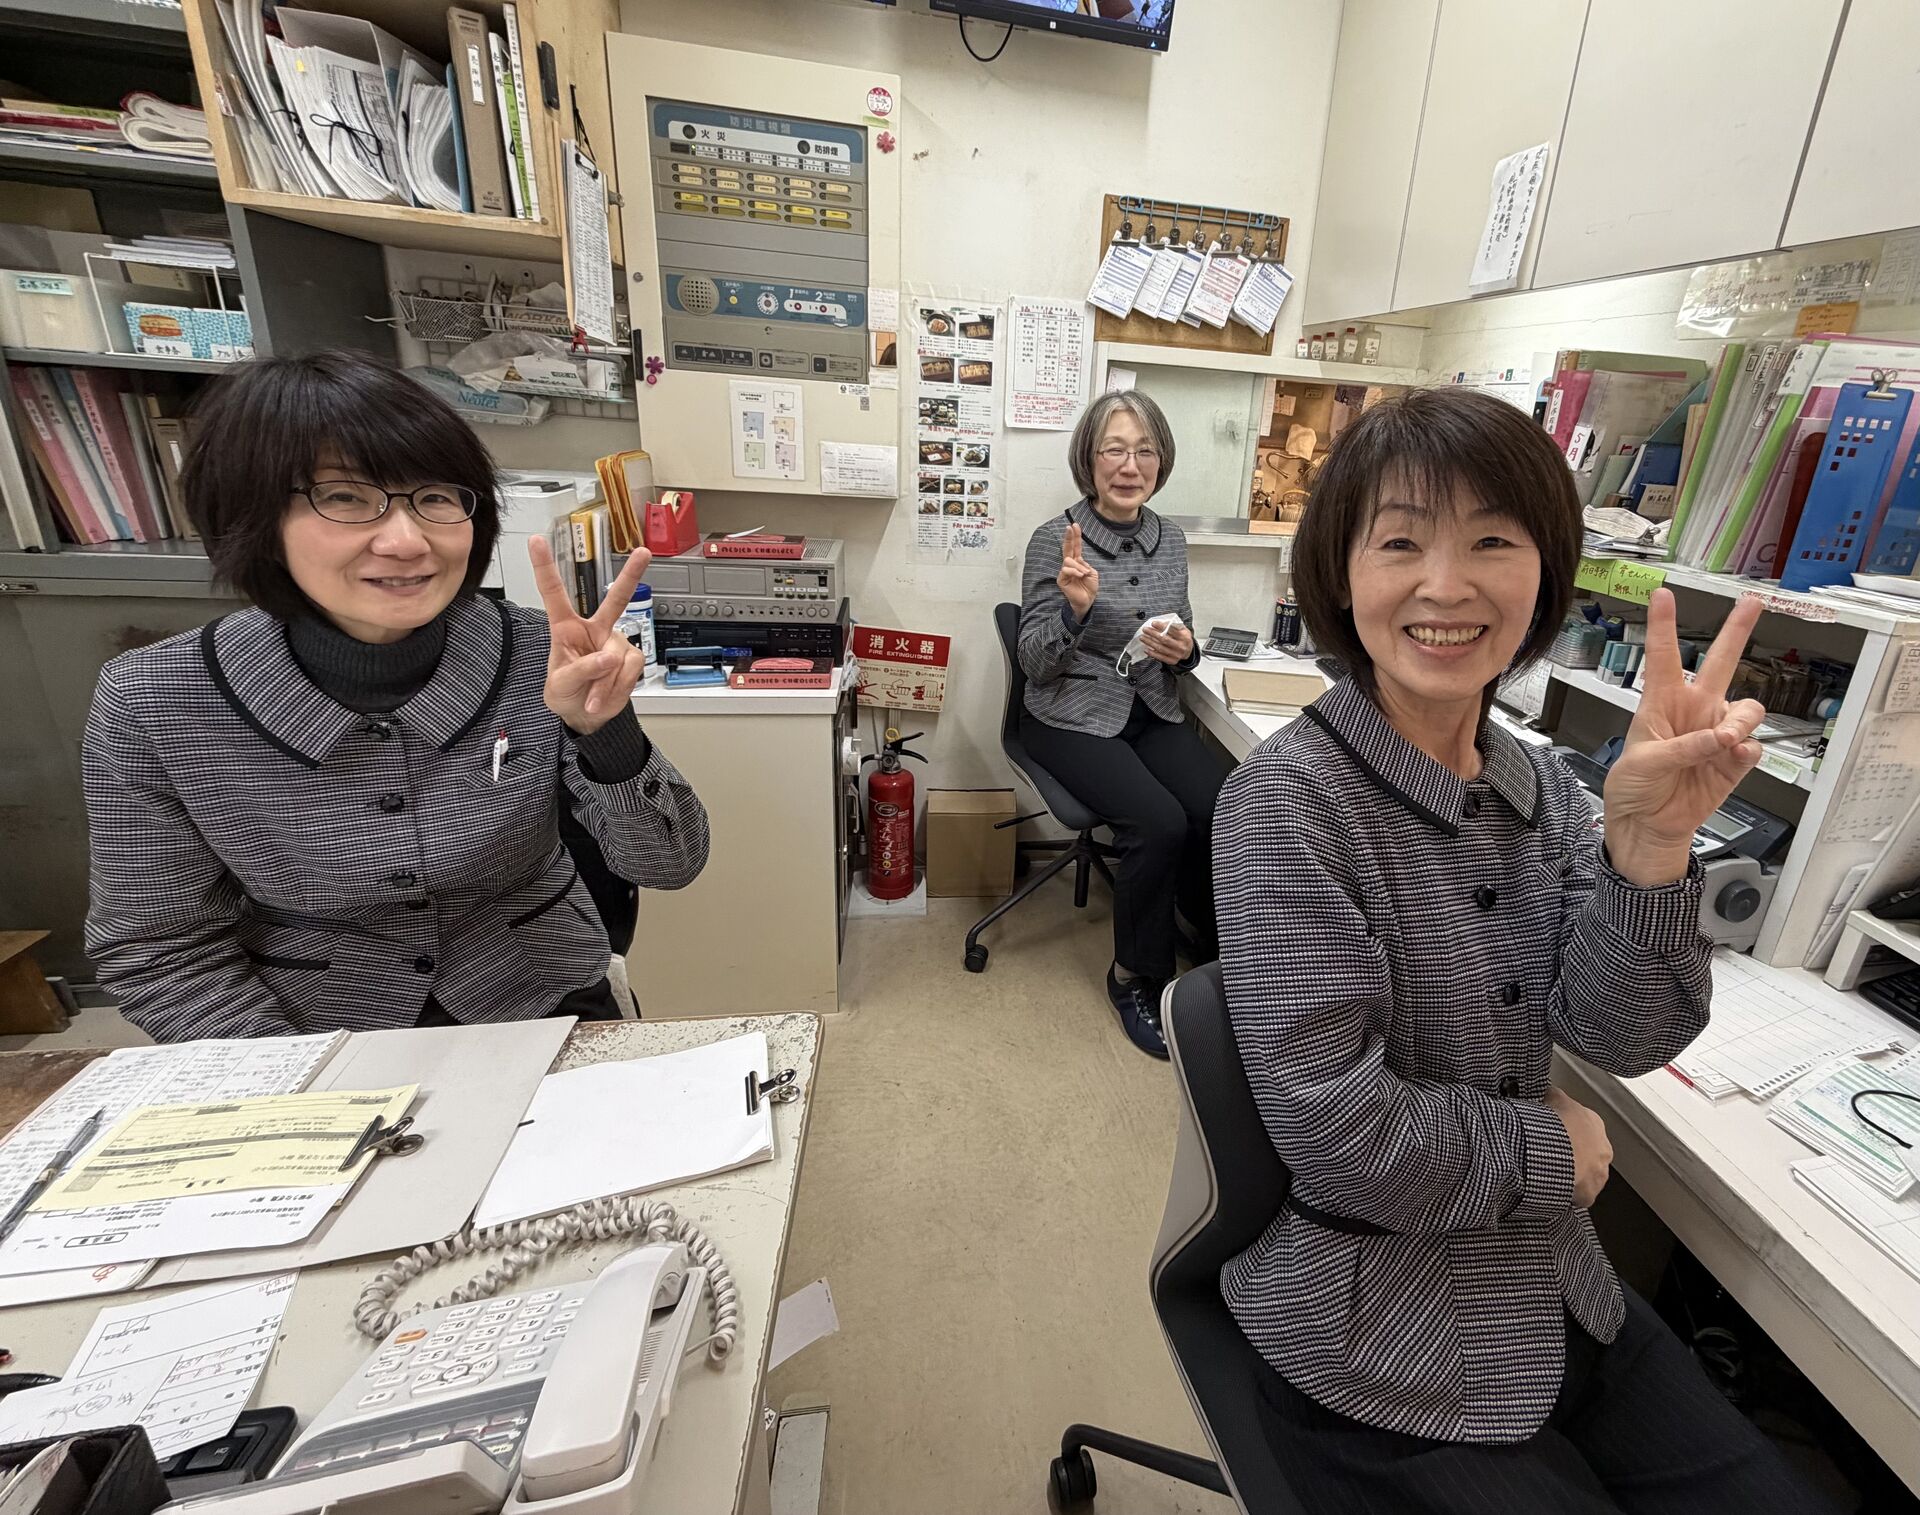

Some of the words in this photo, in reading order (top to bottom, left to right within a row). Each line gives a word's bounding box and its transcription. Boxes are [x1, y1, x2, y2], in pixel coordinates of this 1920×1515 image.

[700, 129, 726, 142] 火災
[814, 144, 839, 156] 防排煙
[788, 288, 795, 299] 1
[815, 291, 824, 302] 2
[869, 634, 935, 655] 消火器
[868, 648, 883, 656] FIRE
[886, 651, 934, 660] EXTINGUISHER
